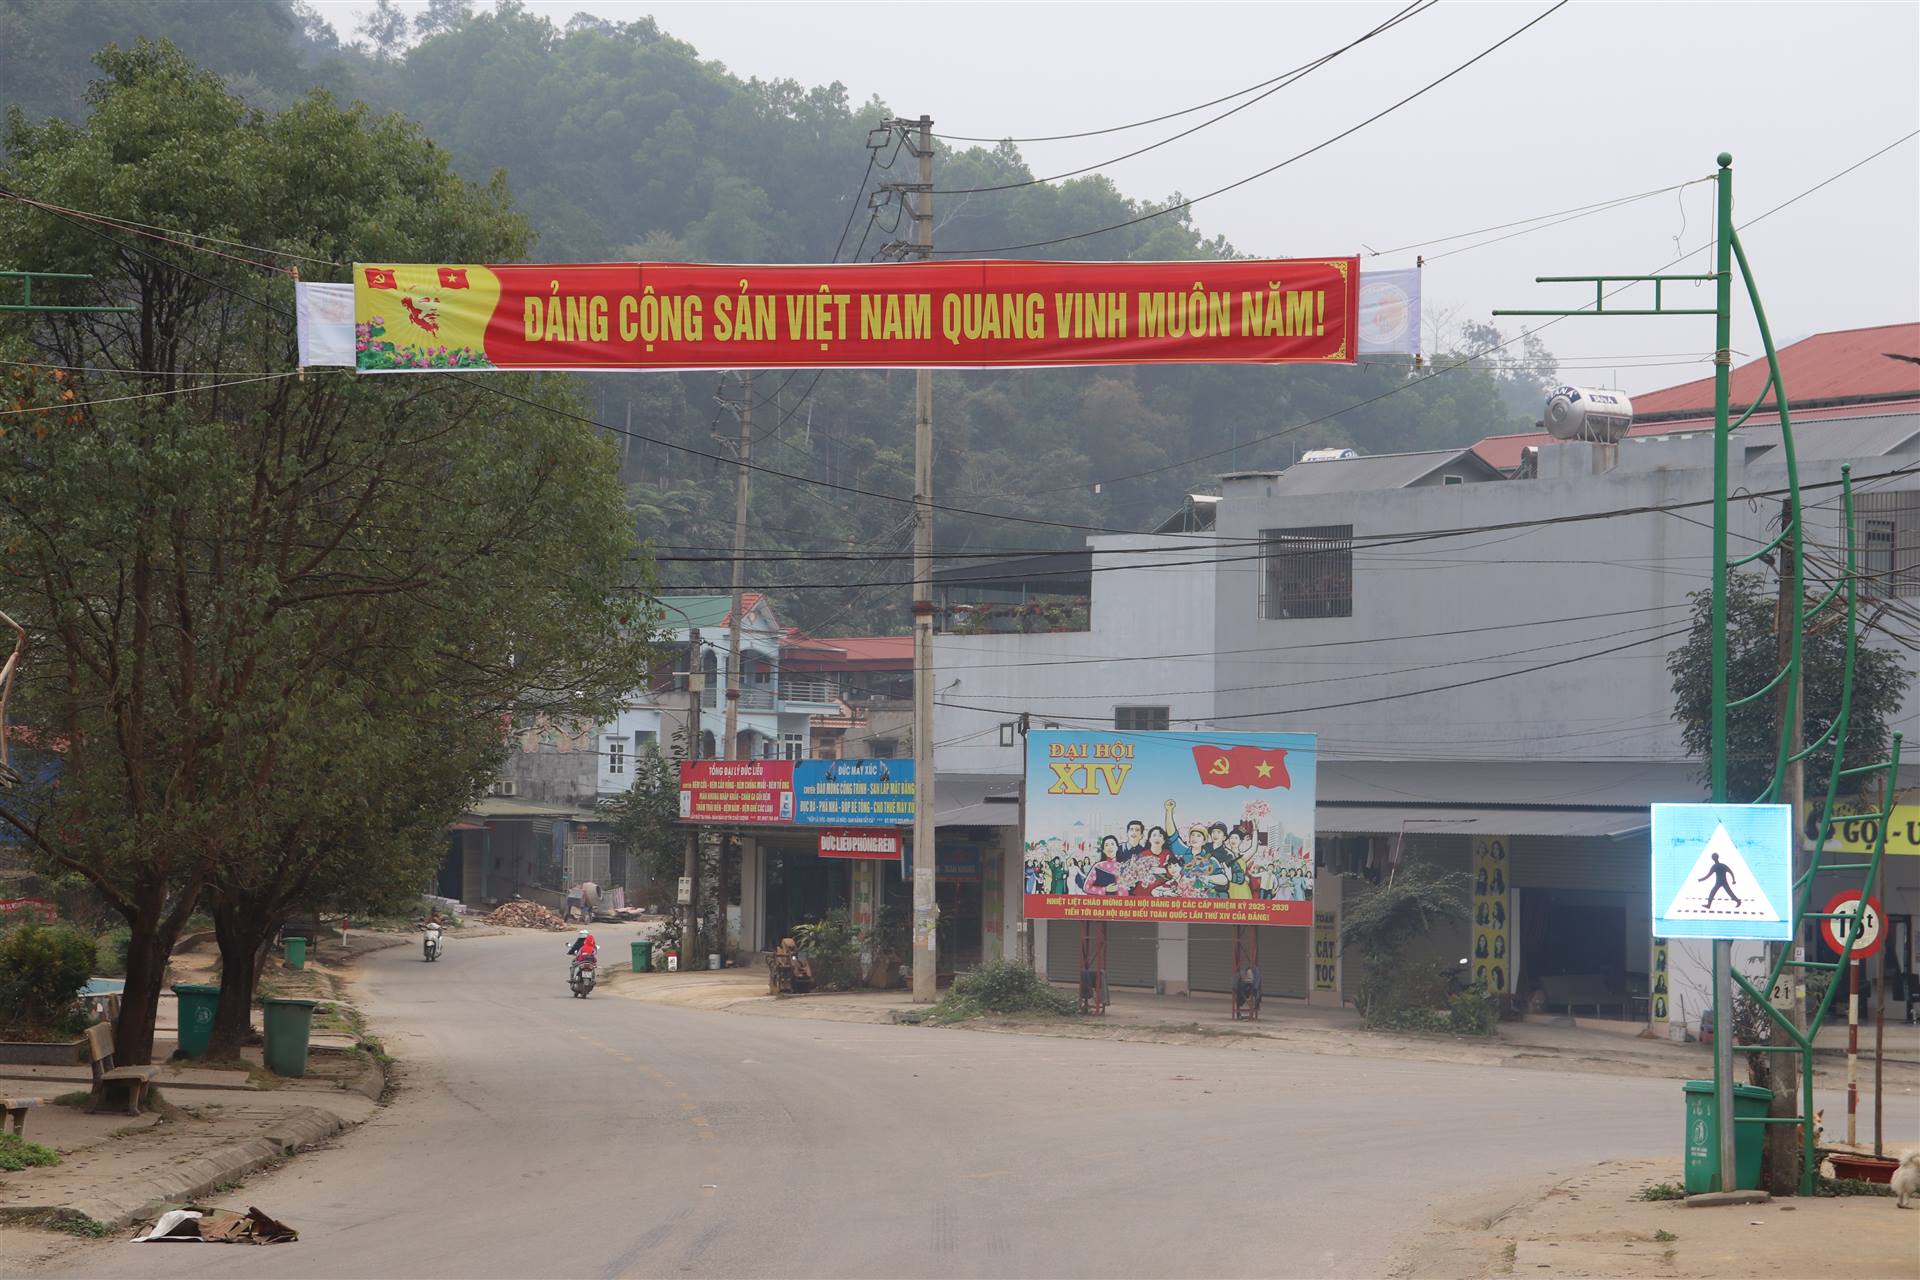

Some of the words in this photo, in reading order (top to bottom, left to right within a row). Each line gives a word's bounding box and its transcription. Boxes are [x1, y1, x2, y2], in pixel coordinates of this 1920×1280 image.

[523, 279, 608, 342] ĐẢNG
[619, 285, 702, 352] CỘNG
[713, 278, 779, 341] SẢN
[788, 284, 850, 351] VIỆT
[861, 293, 932, 340] NAM
[942, 292, 1045, 344] QUANG
[1055, 292, 1127, 339] VINH
[1138, 281, 1235, 338] MUÔN
[1242, 281, 1325, 337] NĂM!
[1049, 743, 1087, 761] ĐẠI
[1095, 741, 1135, 761] HỘI
[1048, 763, 1132, 795] XIV
